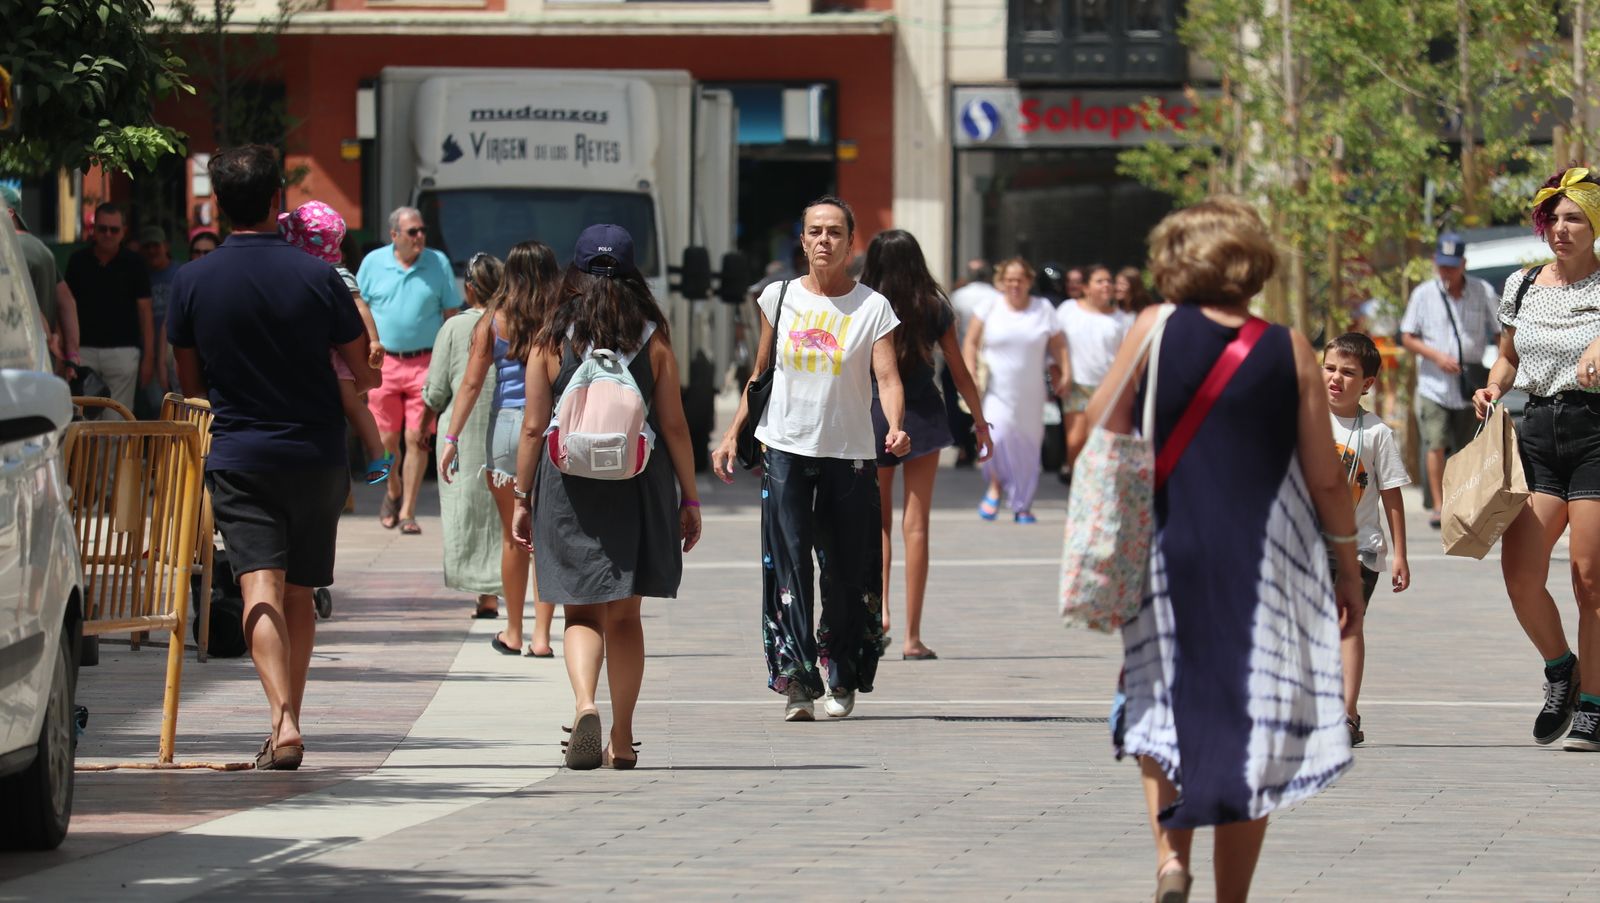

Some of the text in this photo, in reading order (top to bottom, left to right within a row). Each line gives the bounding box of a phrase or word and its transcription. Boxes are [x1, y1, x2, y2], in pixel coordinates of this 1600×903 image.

[470, 106, 609, 123] mudanzas
[1019, 96, 1206, 139] Soloptic
[470, 131, 527, 165] VIRGEN
[575, 133, 620, 168] REYES
